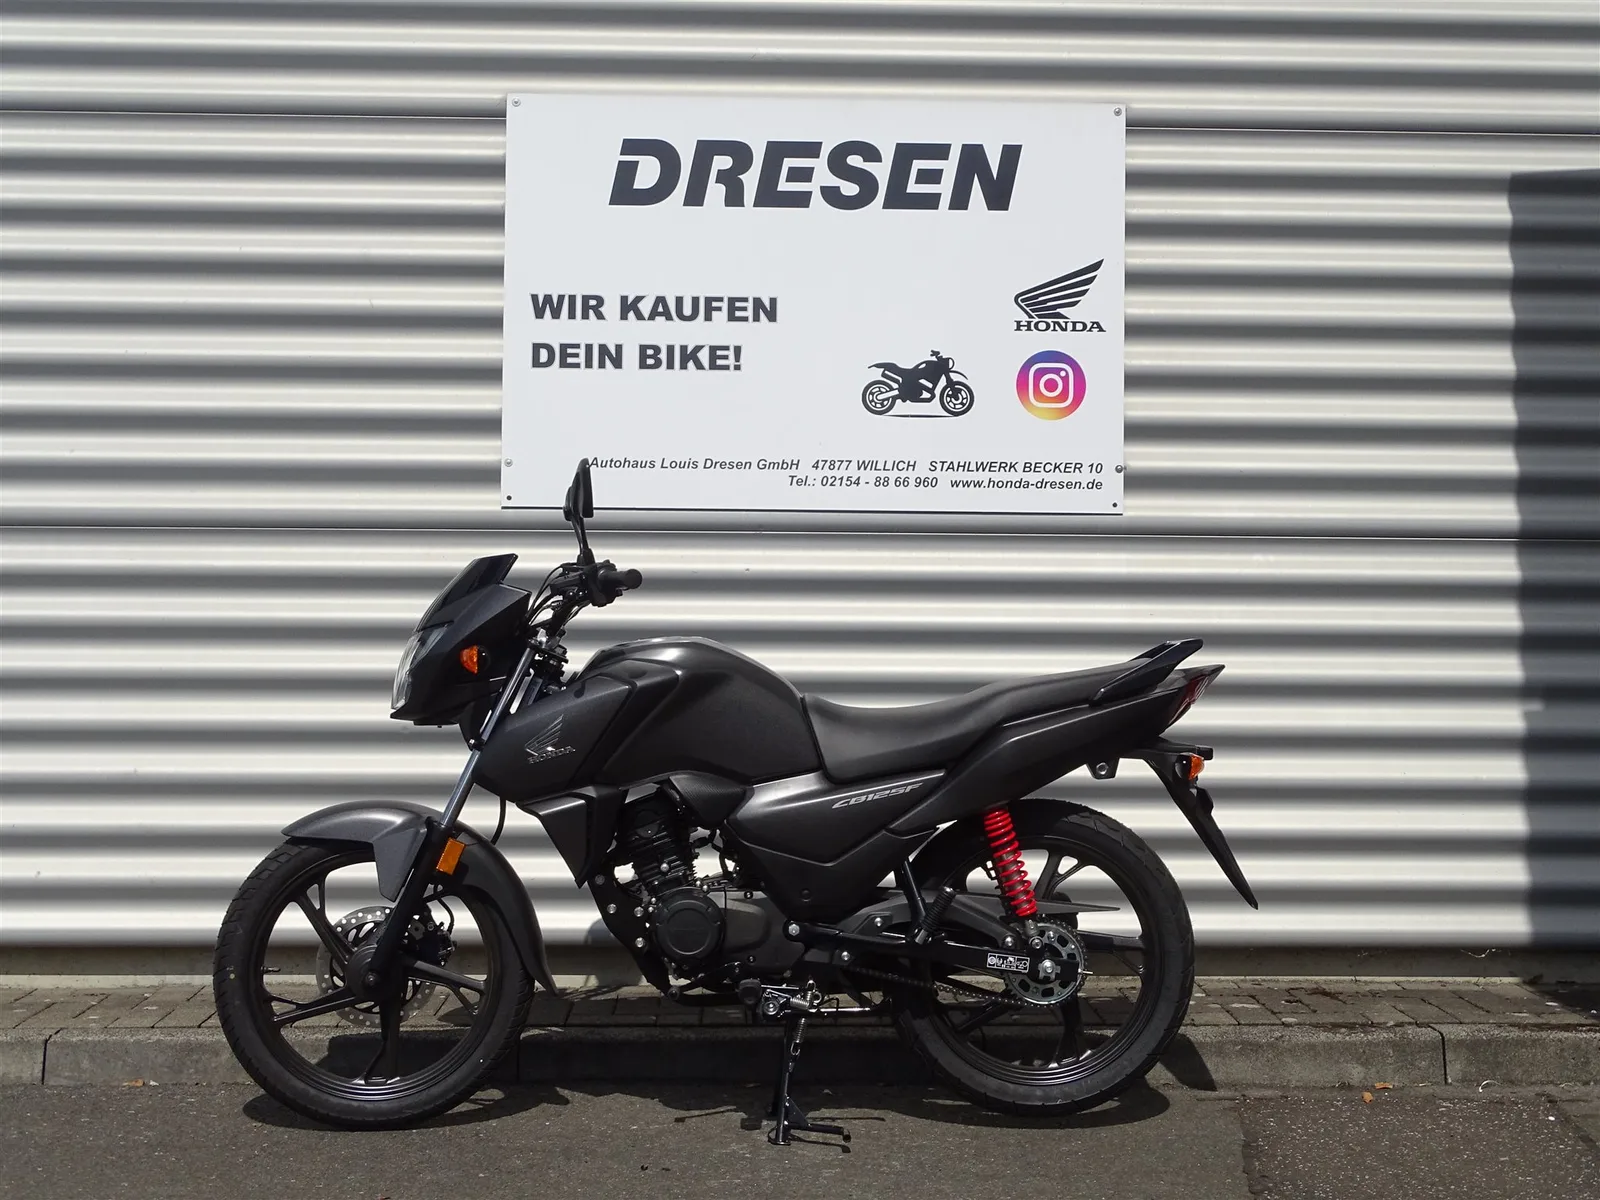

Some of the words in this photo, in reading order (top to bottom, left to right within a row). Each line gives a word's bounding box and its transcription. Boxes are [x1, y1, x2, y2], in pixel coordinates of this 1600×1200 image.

[608, 138, 1022, 212] DRESEN
[530, 293, 606, 321] WIR
[619, 295, 778, 323] KAUFEN
[1013, 320, 1107, 333] HONDA
[531, 342, 623, 370] DEIN
[638, 344, 742, 371] BIKE!
[589, 456, 656, 469] Autohaus
[660, 457, 699, 470] Louis
[702, 457, 752, 470] Dresen
[756, 458, 801, 471] GmbH
[811, 459, 853, 471] 47877
[856, 459, 917, 472] WILLICH
[928, 460, 1019, 473] STAHLWERK
[1022, 461, 1084, 474] BECKER
[1086, 462, 1104, 474] 10
[788, 475, 816, 487] Tel.:
[820, 475, 861, 488] 02154
[873, 476, 891, 488] 88
[893, 476, 911, 488] 66
[913, 476, 939, 489] 960
[950, 477, 1104, 490] www.honda-dresen.de
[831, 782, 924, 809] CB125F
